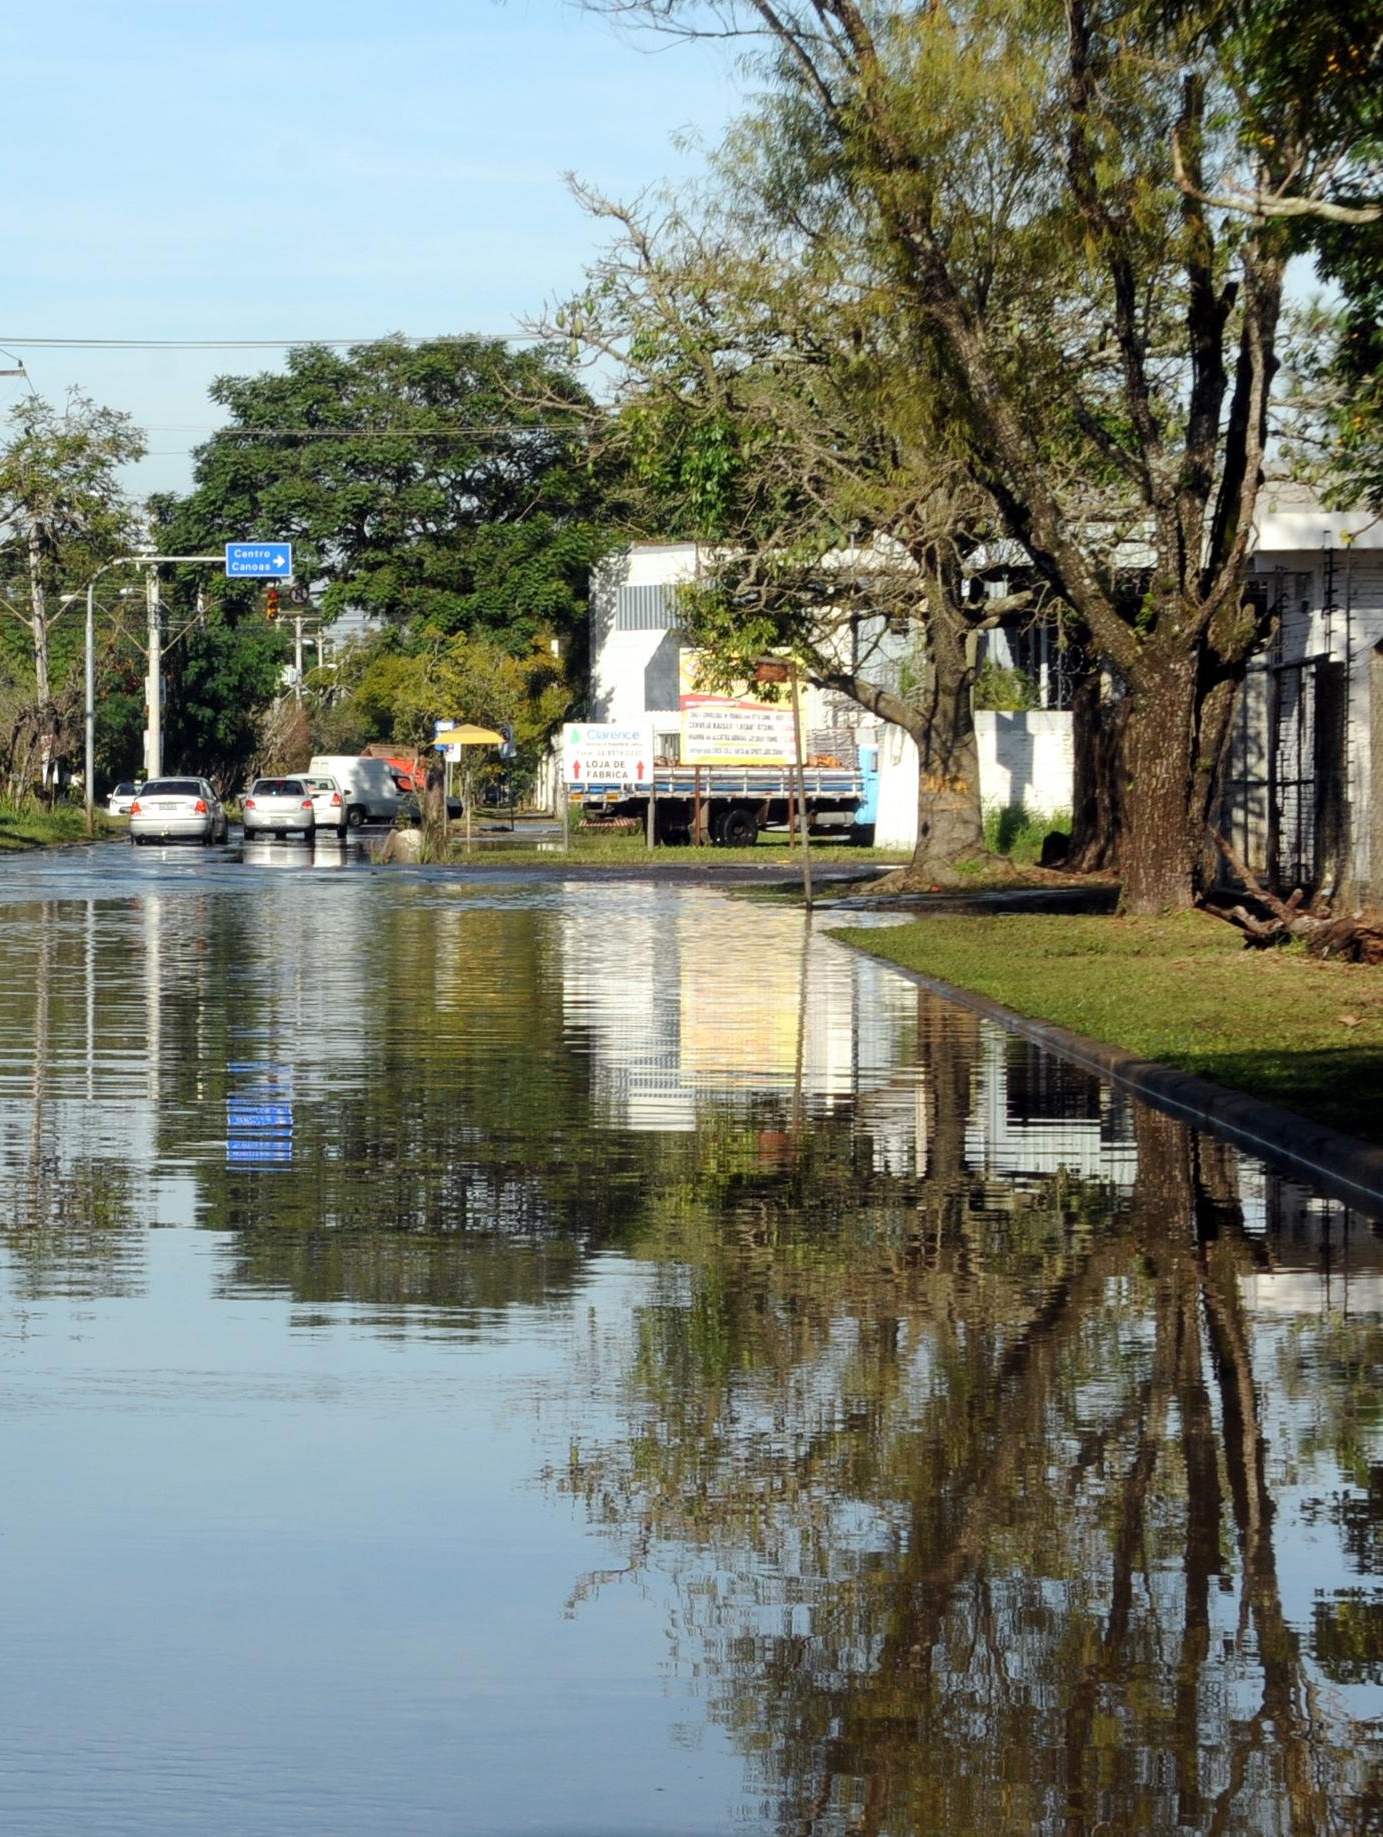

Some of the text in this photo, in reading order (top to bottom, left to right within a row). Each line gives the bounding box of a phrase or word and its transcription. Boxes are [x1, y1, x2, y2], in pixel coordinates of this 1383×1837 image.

[233, 549, 272, 559] Centro
[231, 561, 272, 571] Canoas
[586, 728, 640, 740] Clarence
[586, 760, 626, 769] LOJA DE
